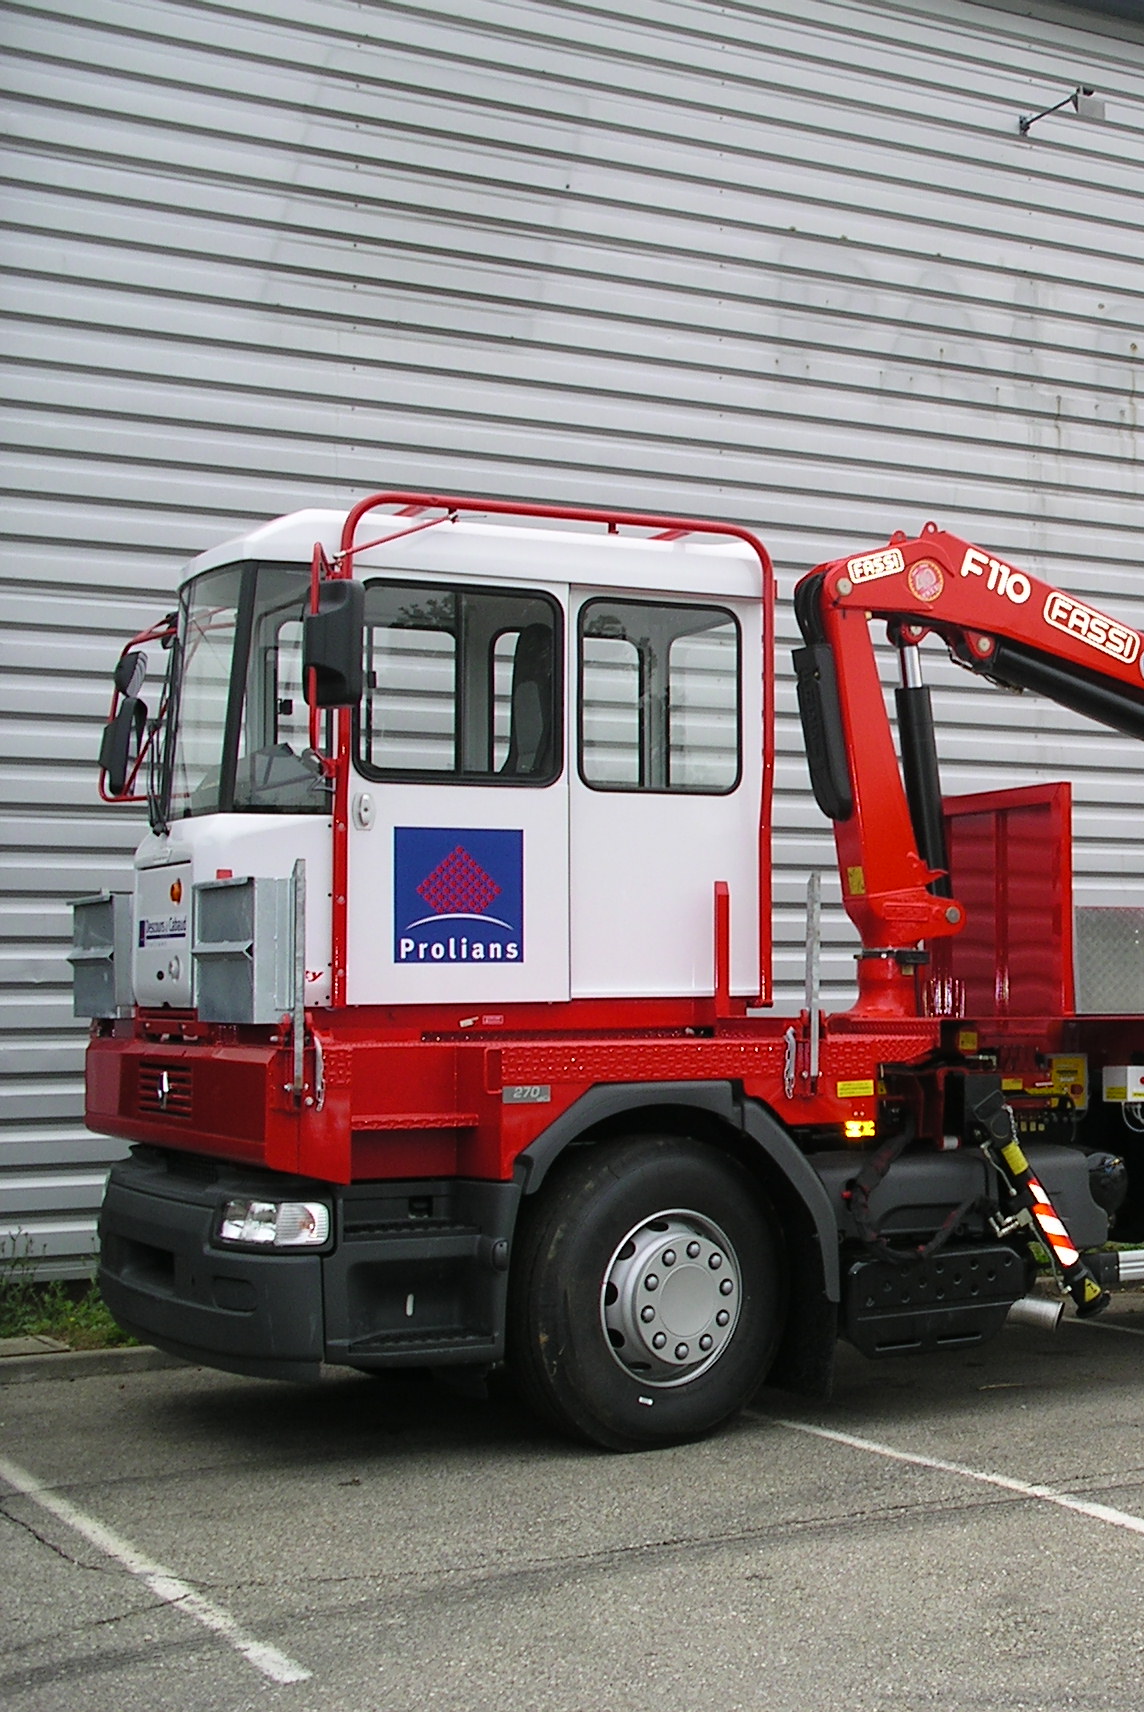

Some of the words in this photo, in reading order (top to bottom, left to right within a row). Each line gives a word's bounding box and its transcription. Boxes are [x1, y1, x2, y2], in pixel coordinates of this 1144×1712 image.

[852, 552, 901, 580] FASSI
[960, 547, 1032, 605] F110
[1051, 598, 1134, 659] FASSI
[399, 936, 520, 960] Prolians
[512, 1086, 541, 1099] 270
